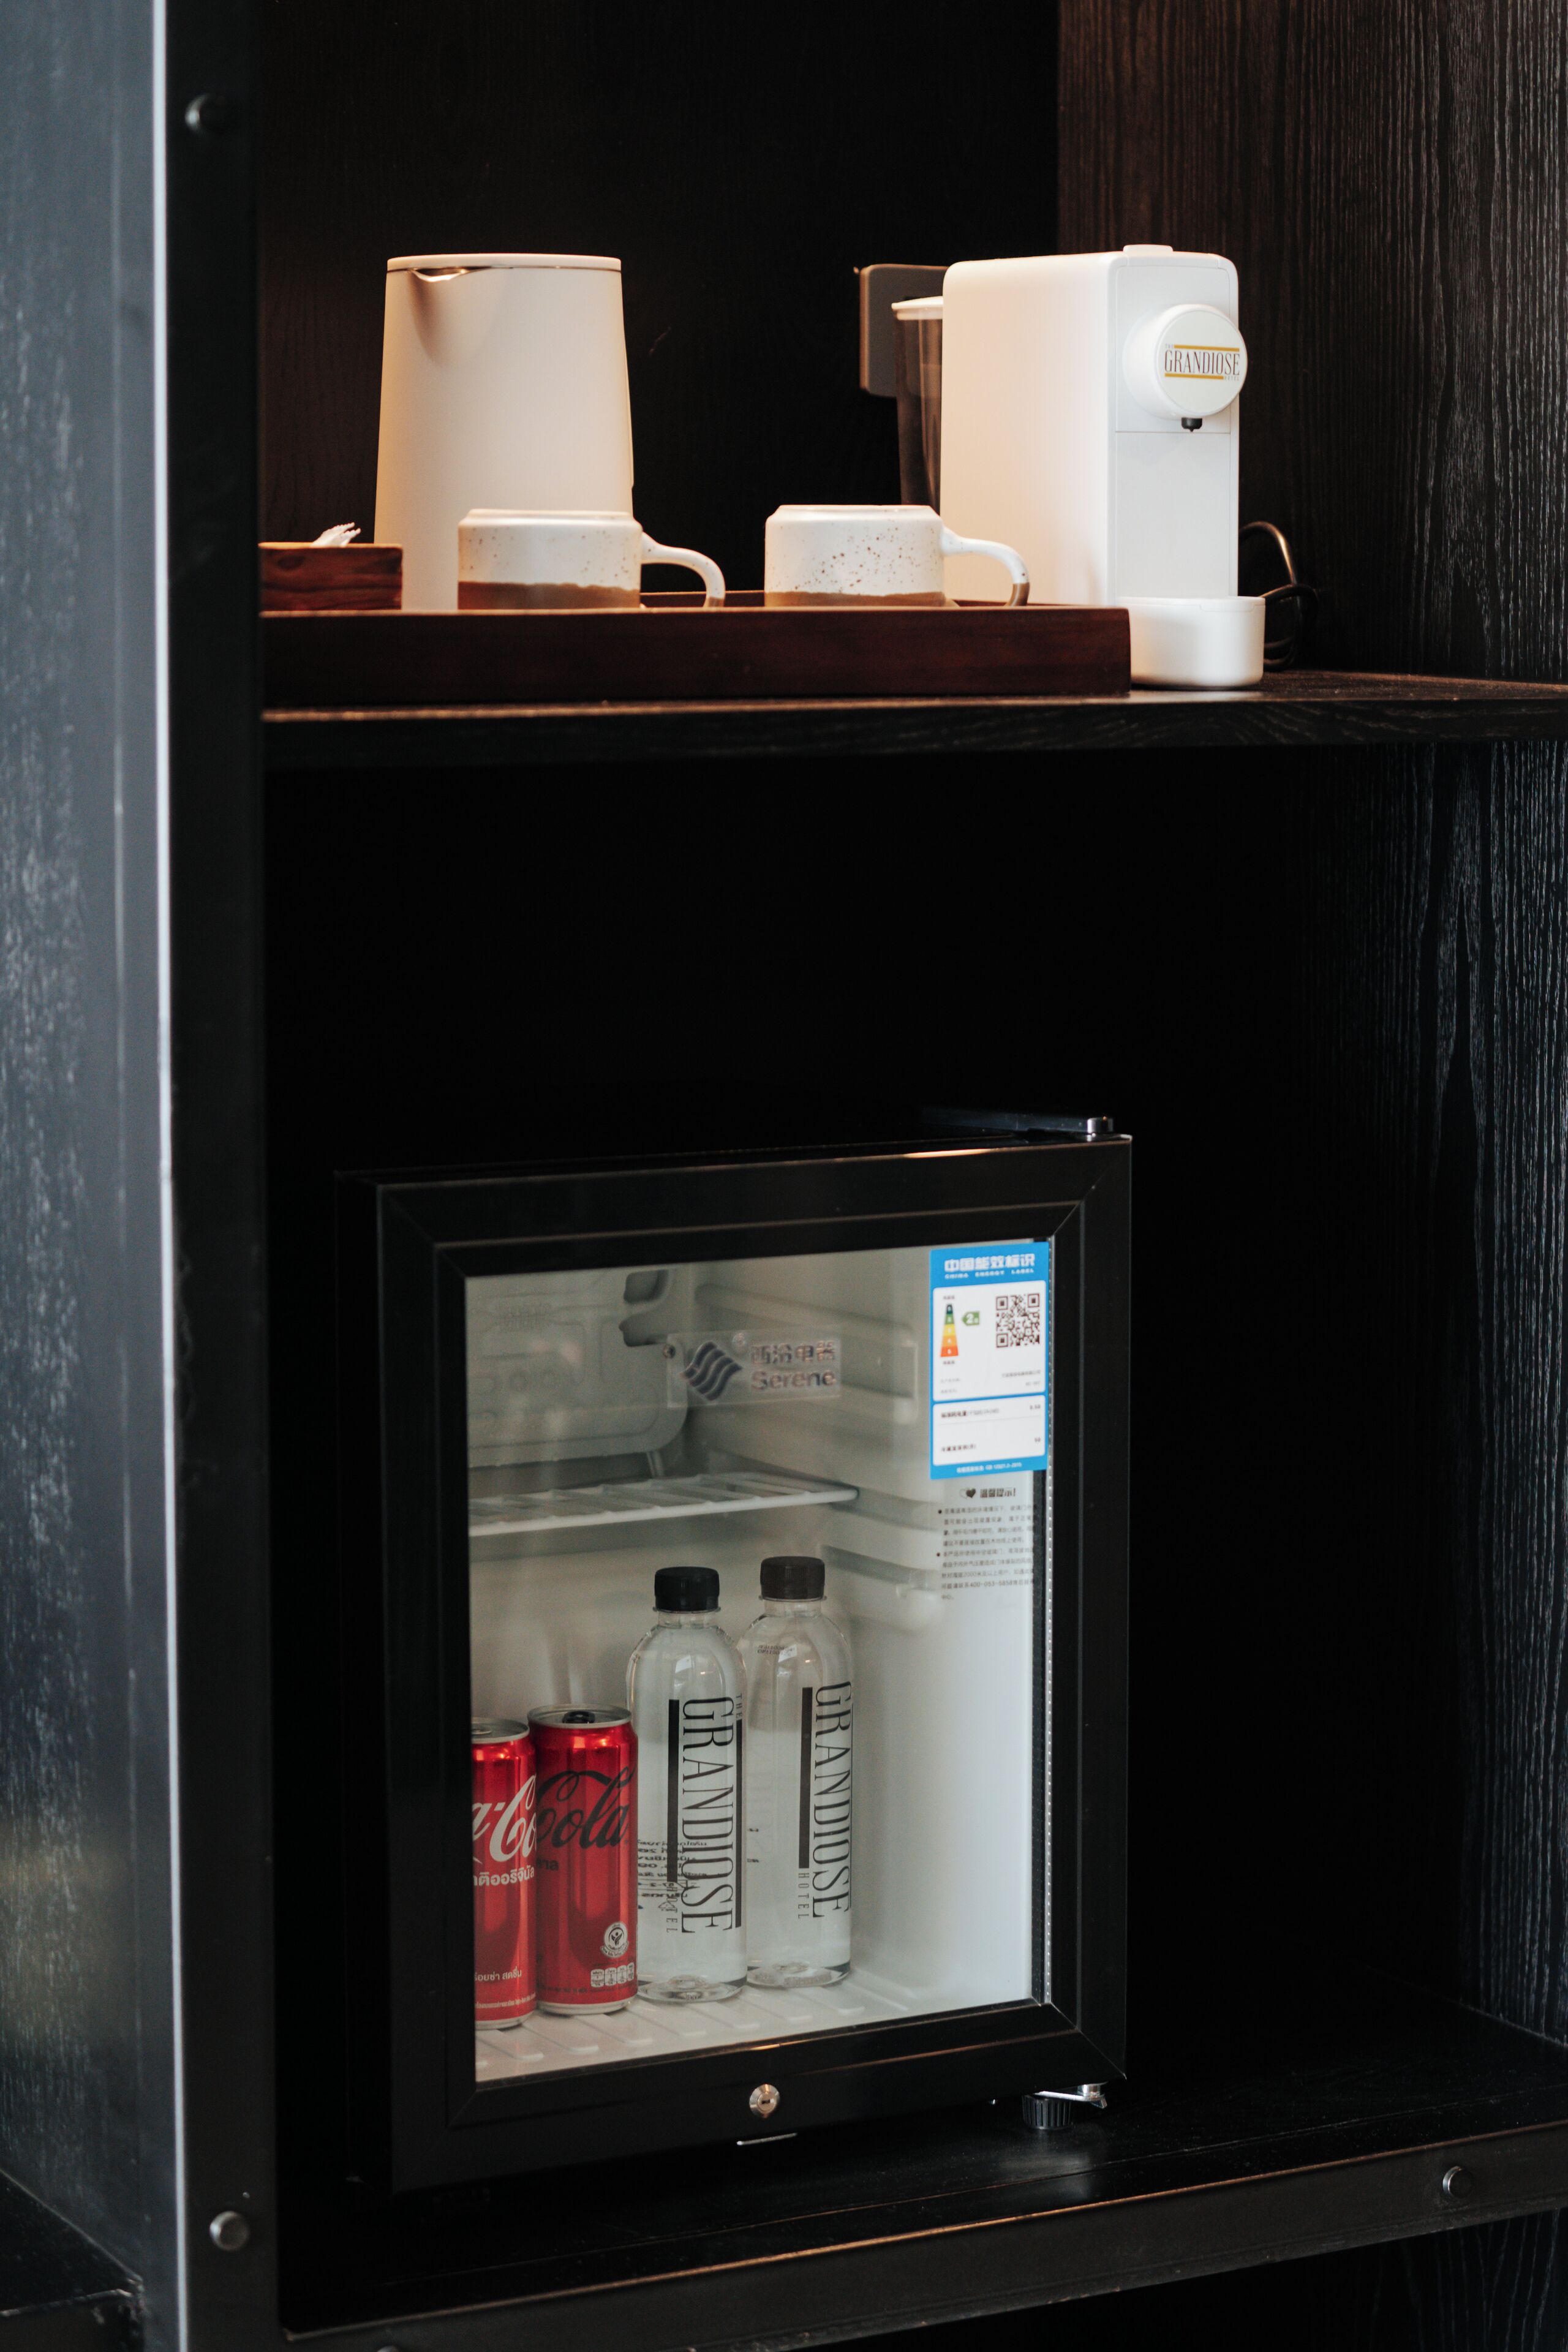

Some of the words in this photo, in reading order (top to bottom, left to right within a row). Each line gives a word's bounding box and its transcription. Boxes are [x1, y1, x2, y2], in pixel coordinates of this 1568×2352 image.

[1164, 349, 1240, 375] GRANDIOSE
[944, 1253, 1035, 1272] 中国能效标识
[751, 1370, 837, 1390] Serene
[681, 1696, 734, 1934] GRANDIOSE
[812, 1681, 851, 1918] GRANDIOSE
[797, 1872, 810, 1919] HOTEL
